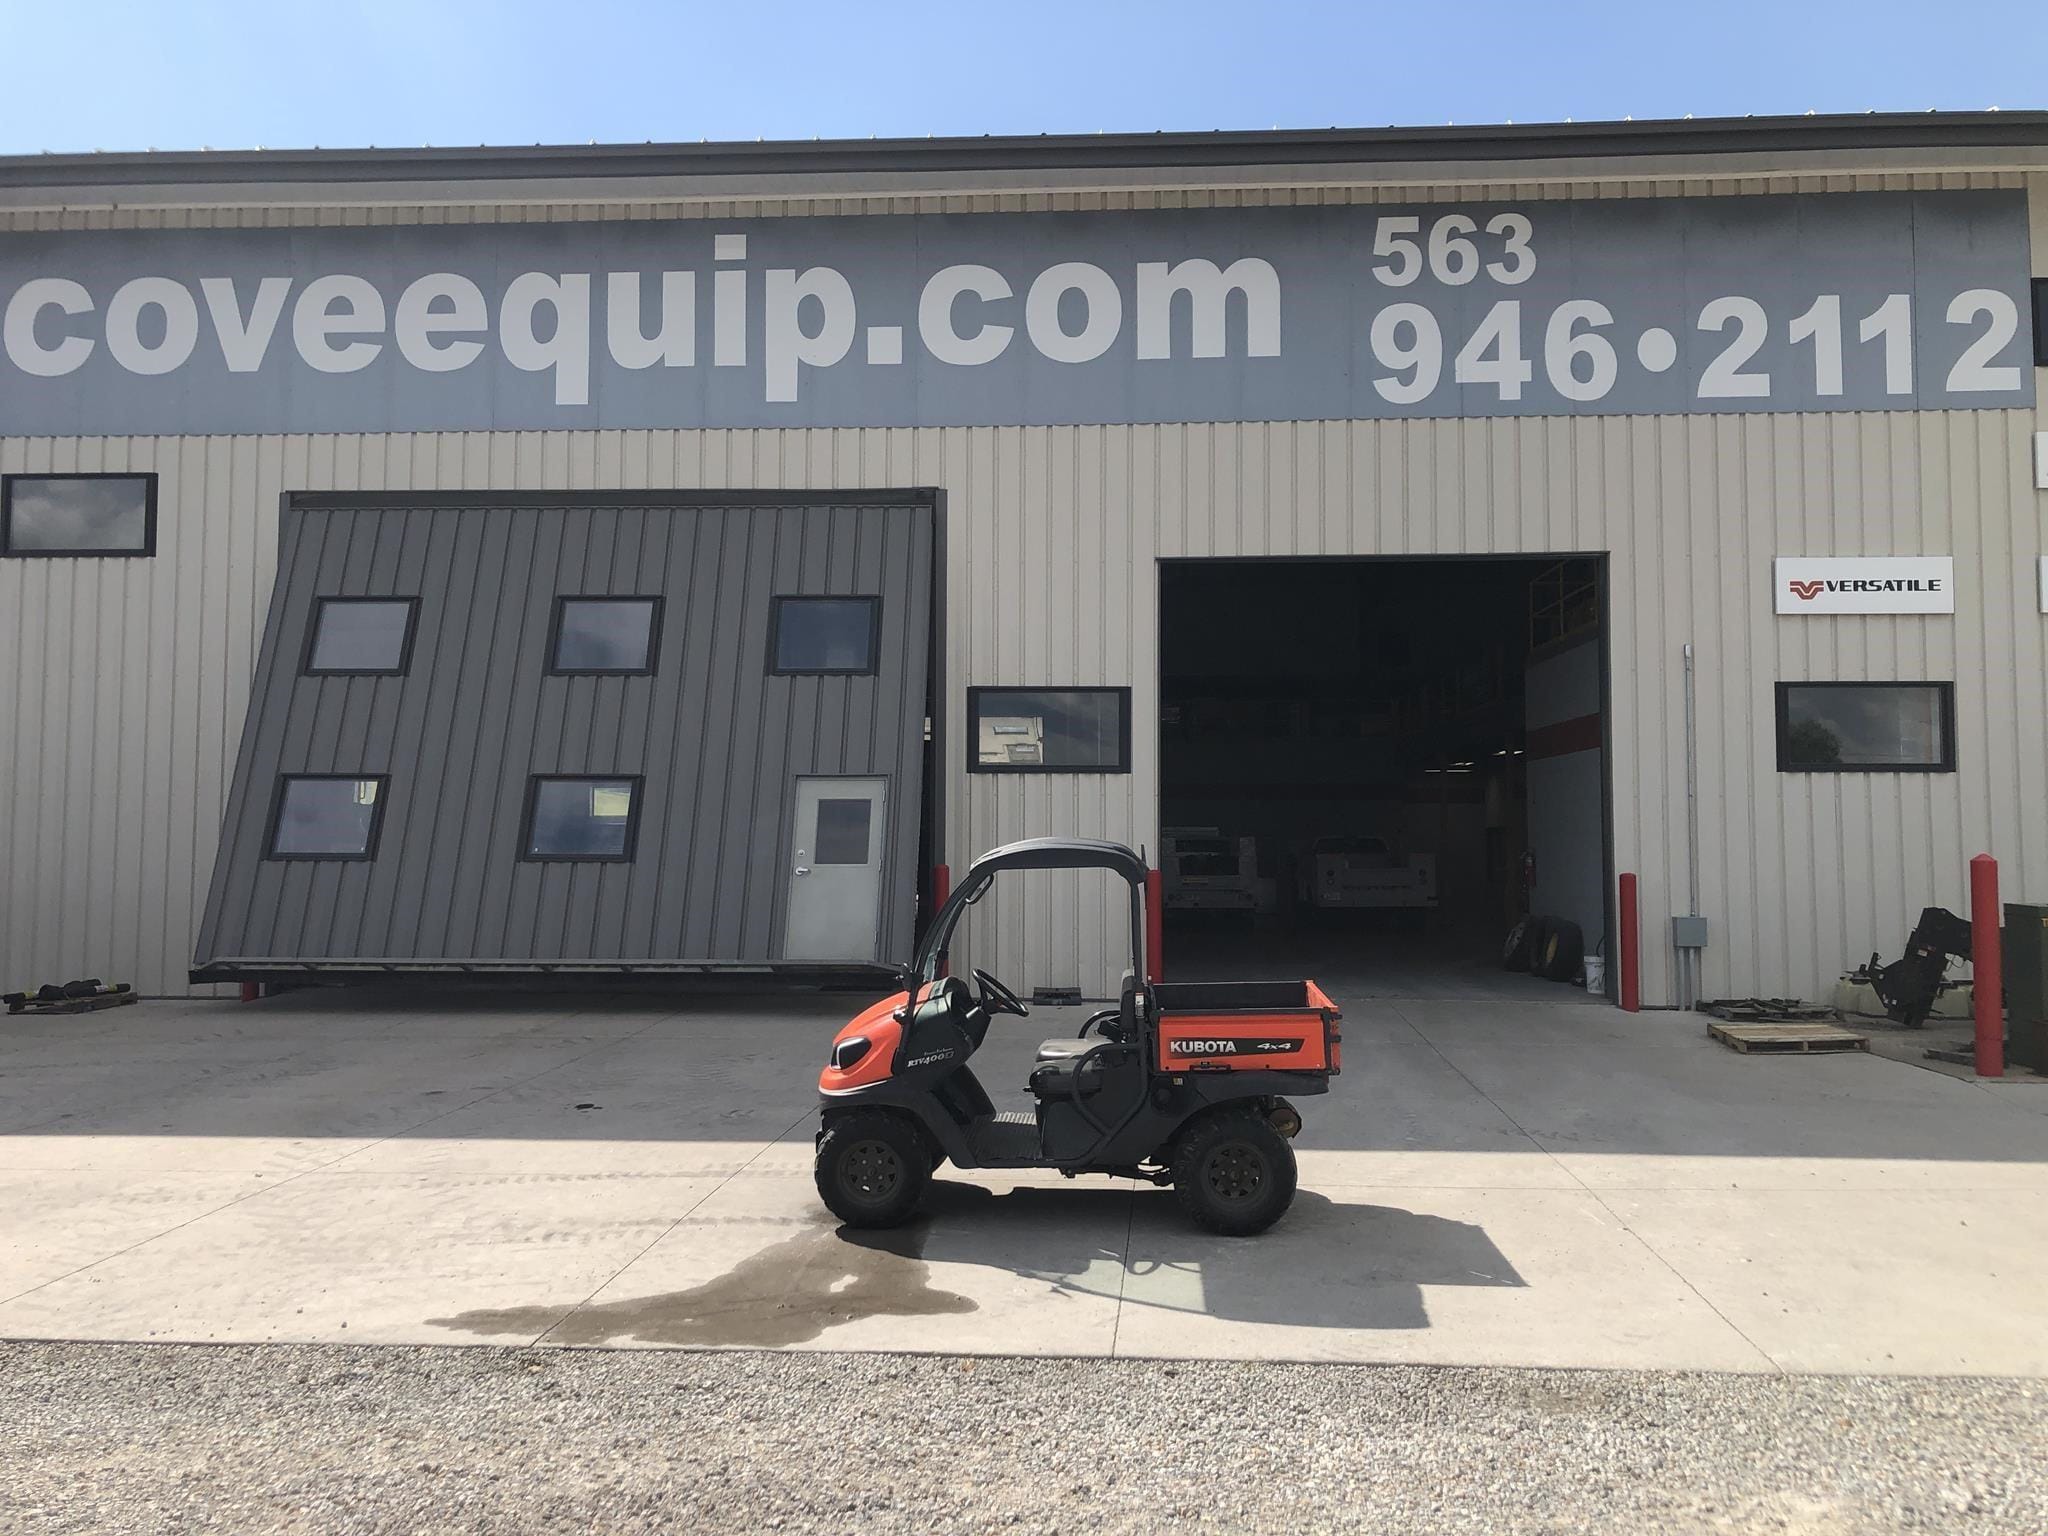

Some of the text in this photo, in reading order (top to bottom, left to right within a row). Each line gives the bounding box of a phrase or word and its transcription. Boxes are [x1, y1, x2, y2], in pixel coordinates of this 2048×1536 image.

[1371, 213, 1537, 287] 563
[4, 233, 1282, 407] coveequip.com
[1825, 579, 1942, 592] VERSATILE
[1170, 1040, 1292, 1053] KUBOTA 4x4
